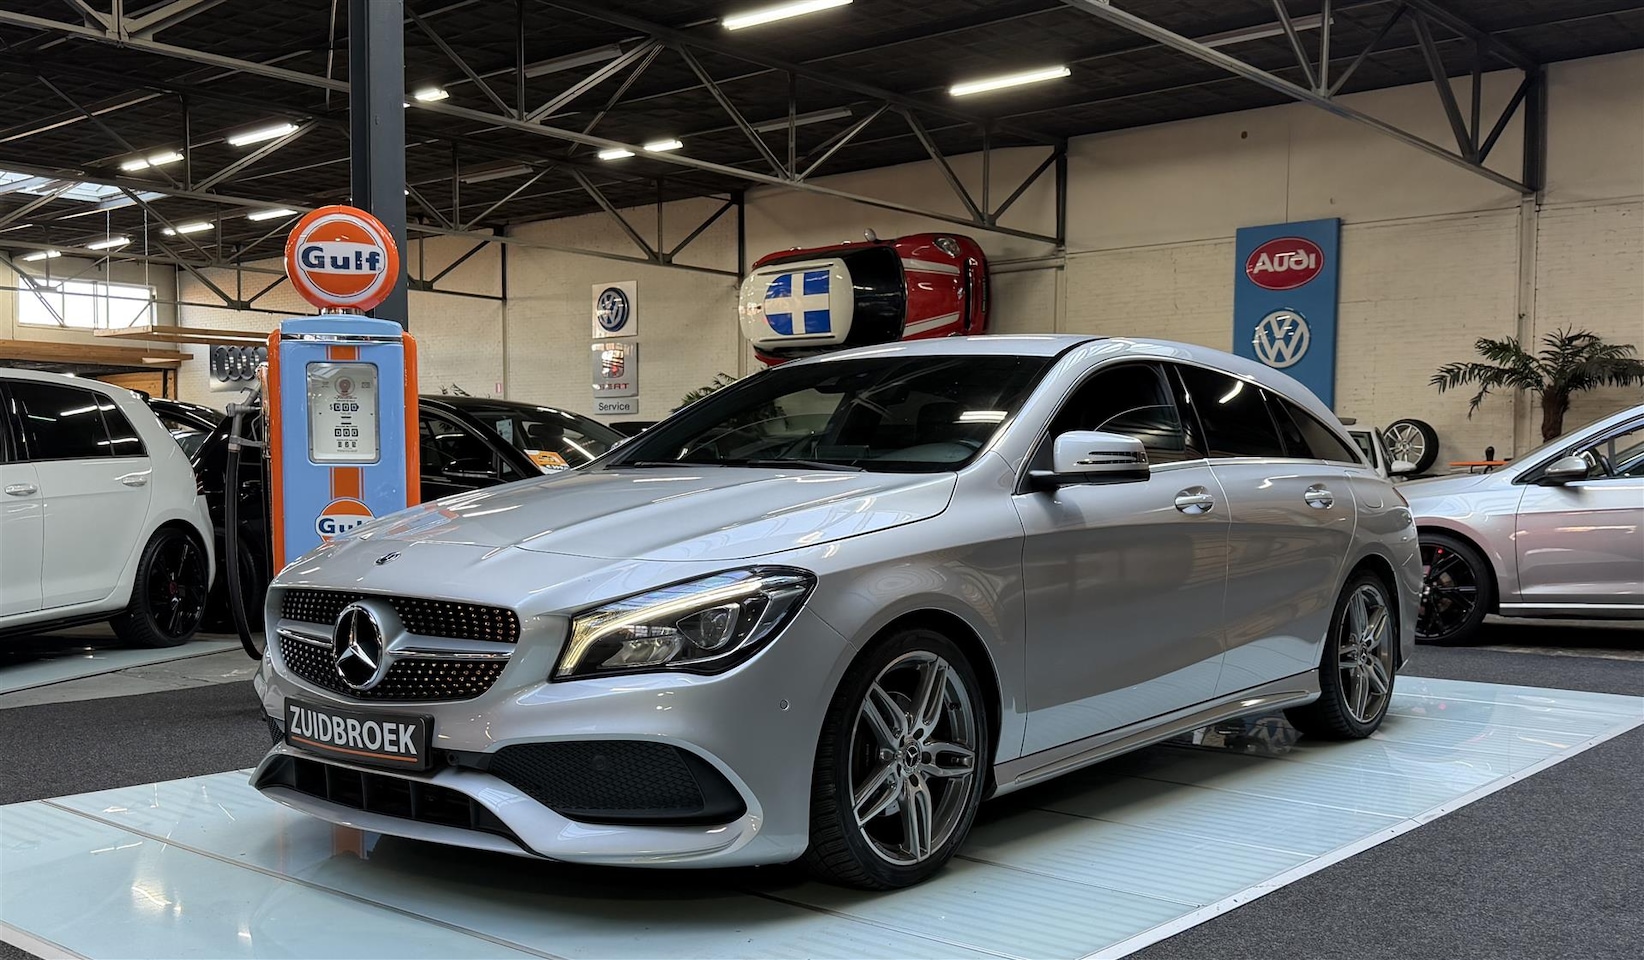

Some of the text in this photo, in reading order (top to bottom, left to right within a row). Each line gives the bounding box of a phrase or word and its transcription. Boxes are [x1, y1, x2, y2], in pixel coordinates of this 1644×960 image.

[301, 246, 380, 271] Gulf
[598, 402, 630, 411] Service
[318, 518, 363, 534] Gu
[289, 705, 417, 755] ZUIDBROEK
